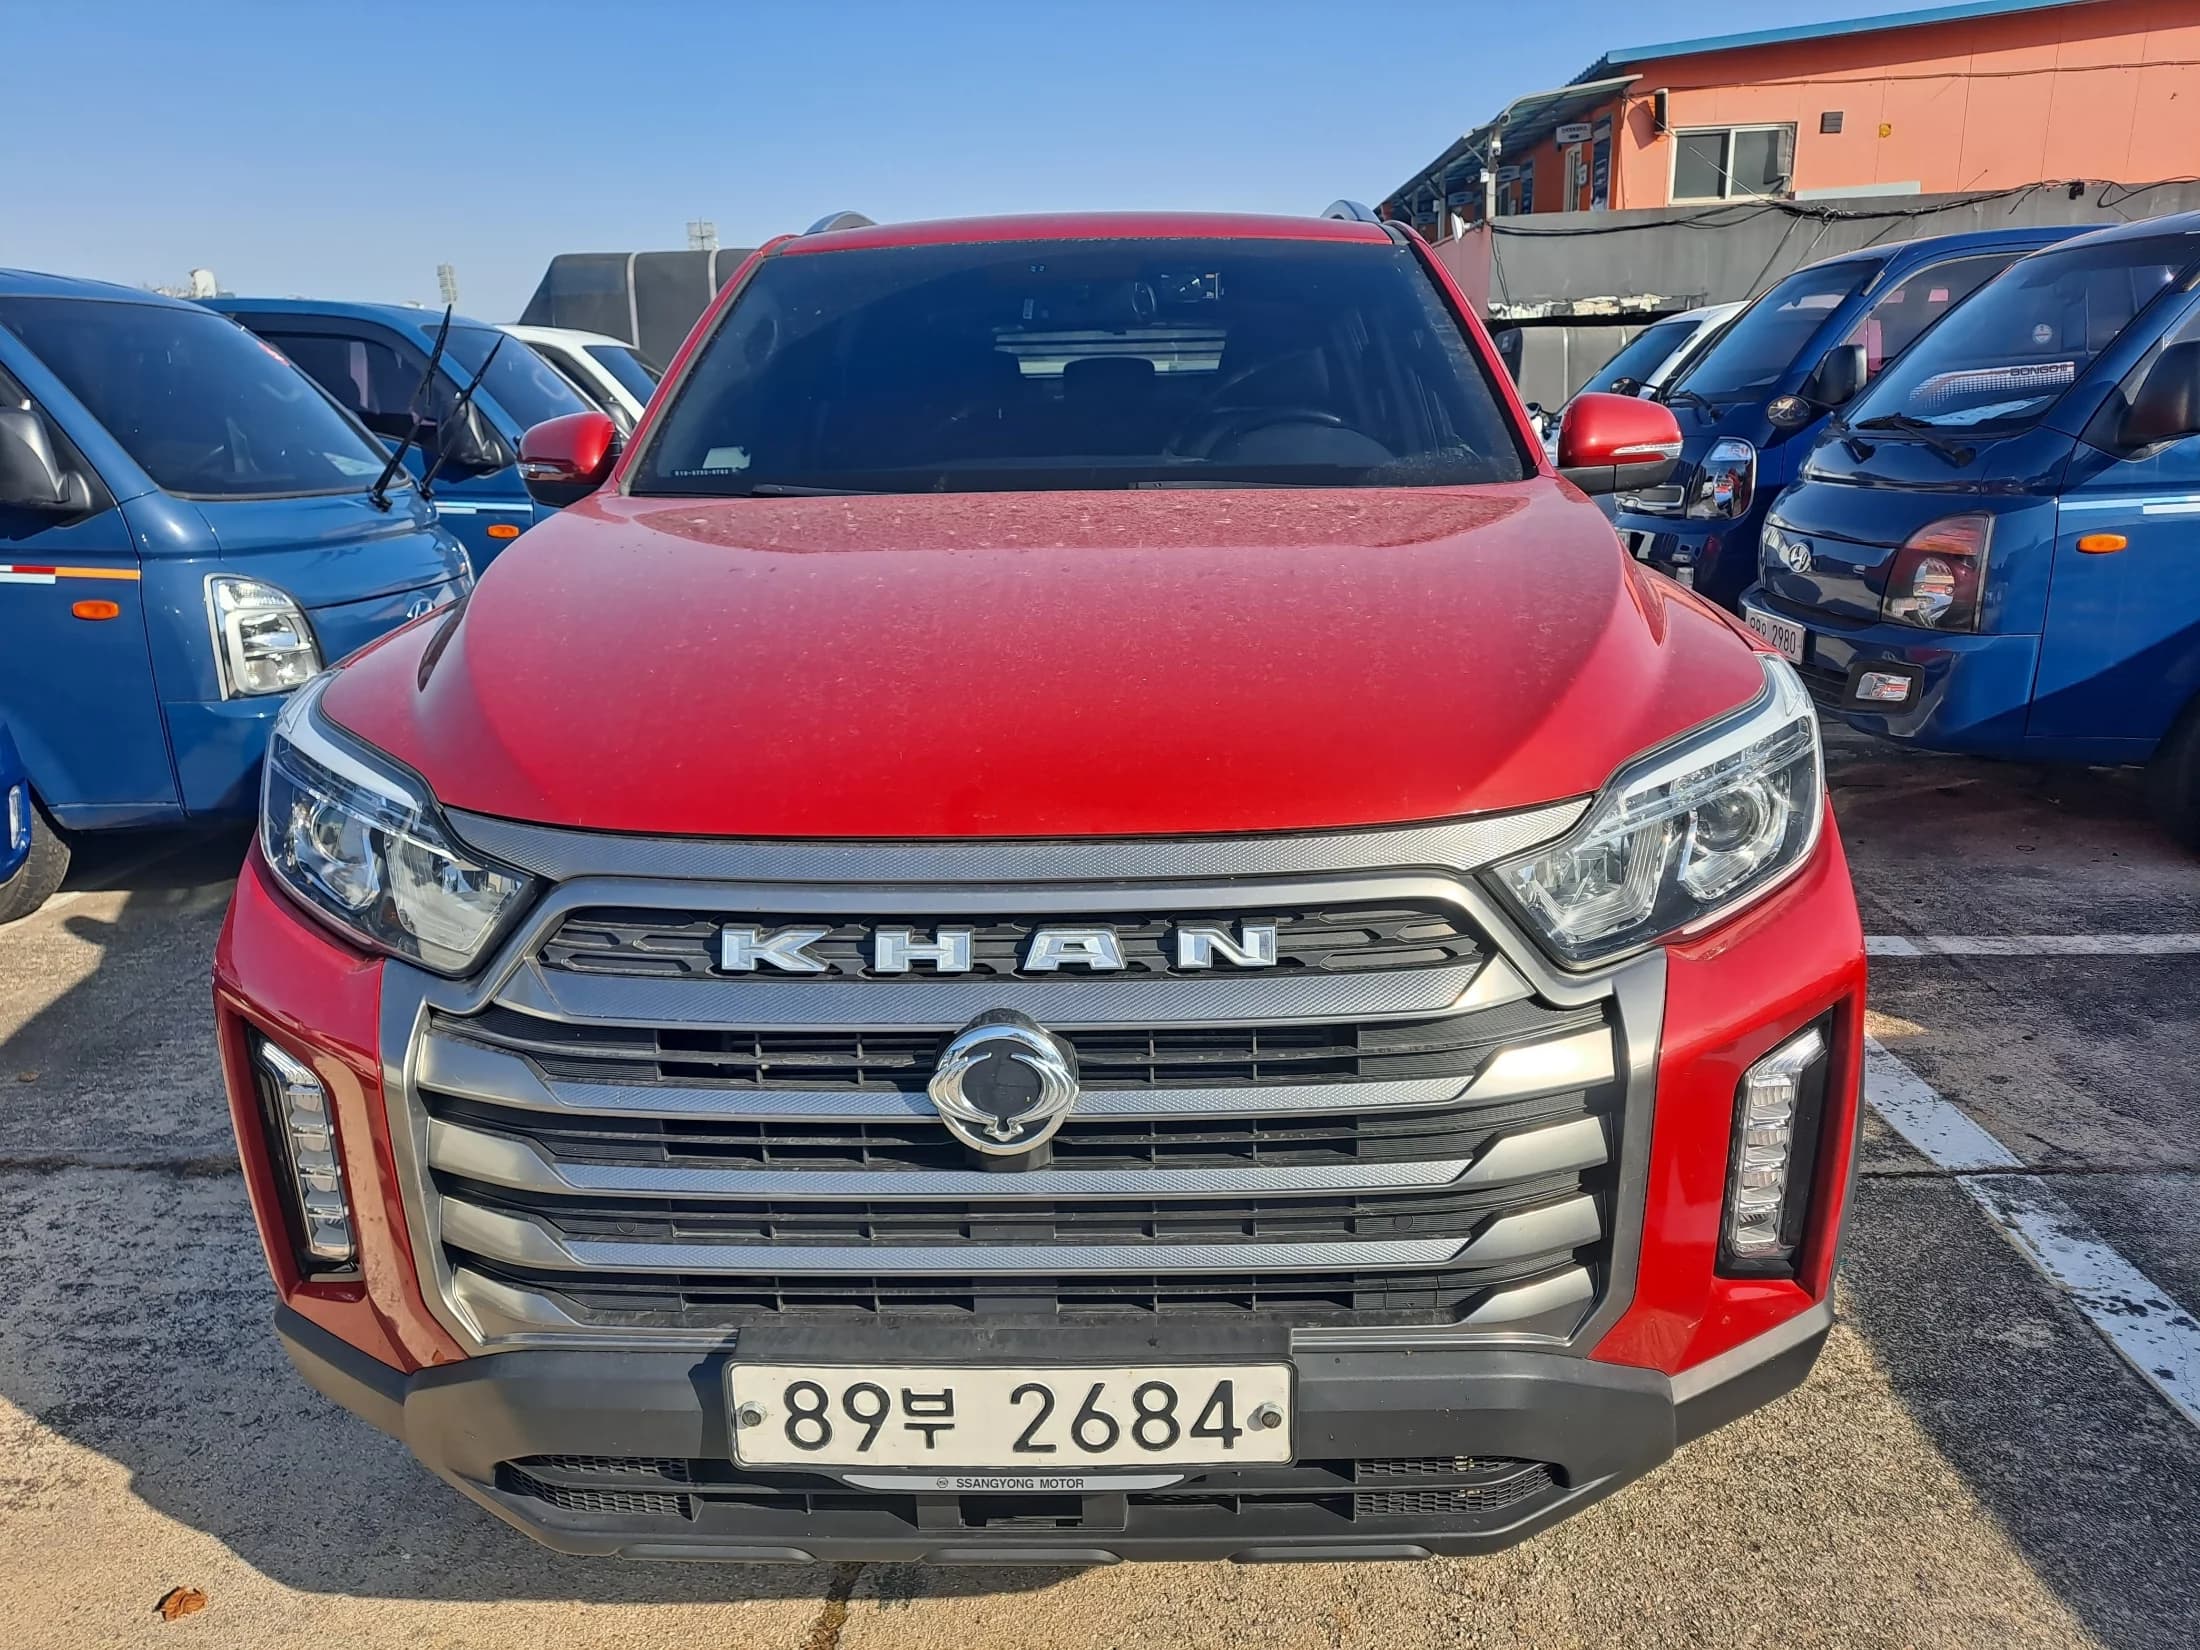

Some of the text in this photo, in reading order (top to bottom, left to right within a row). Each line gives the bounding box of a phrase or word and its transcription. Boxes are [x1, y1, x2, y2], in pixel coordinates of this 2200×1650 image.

[2010, 364, 2059, 376] BONGO
[1772, 624, 1796, 654] 2980
[721, 919, 1278, 973] KHAN
[783, 1379, 1244, 1454] 89부 2684
[956, 1478, 1084, 1489] SSANGYONG MOTOR
